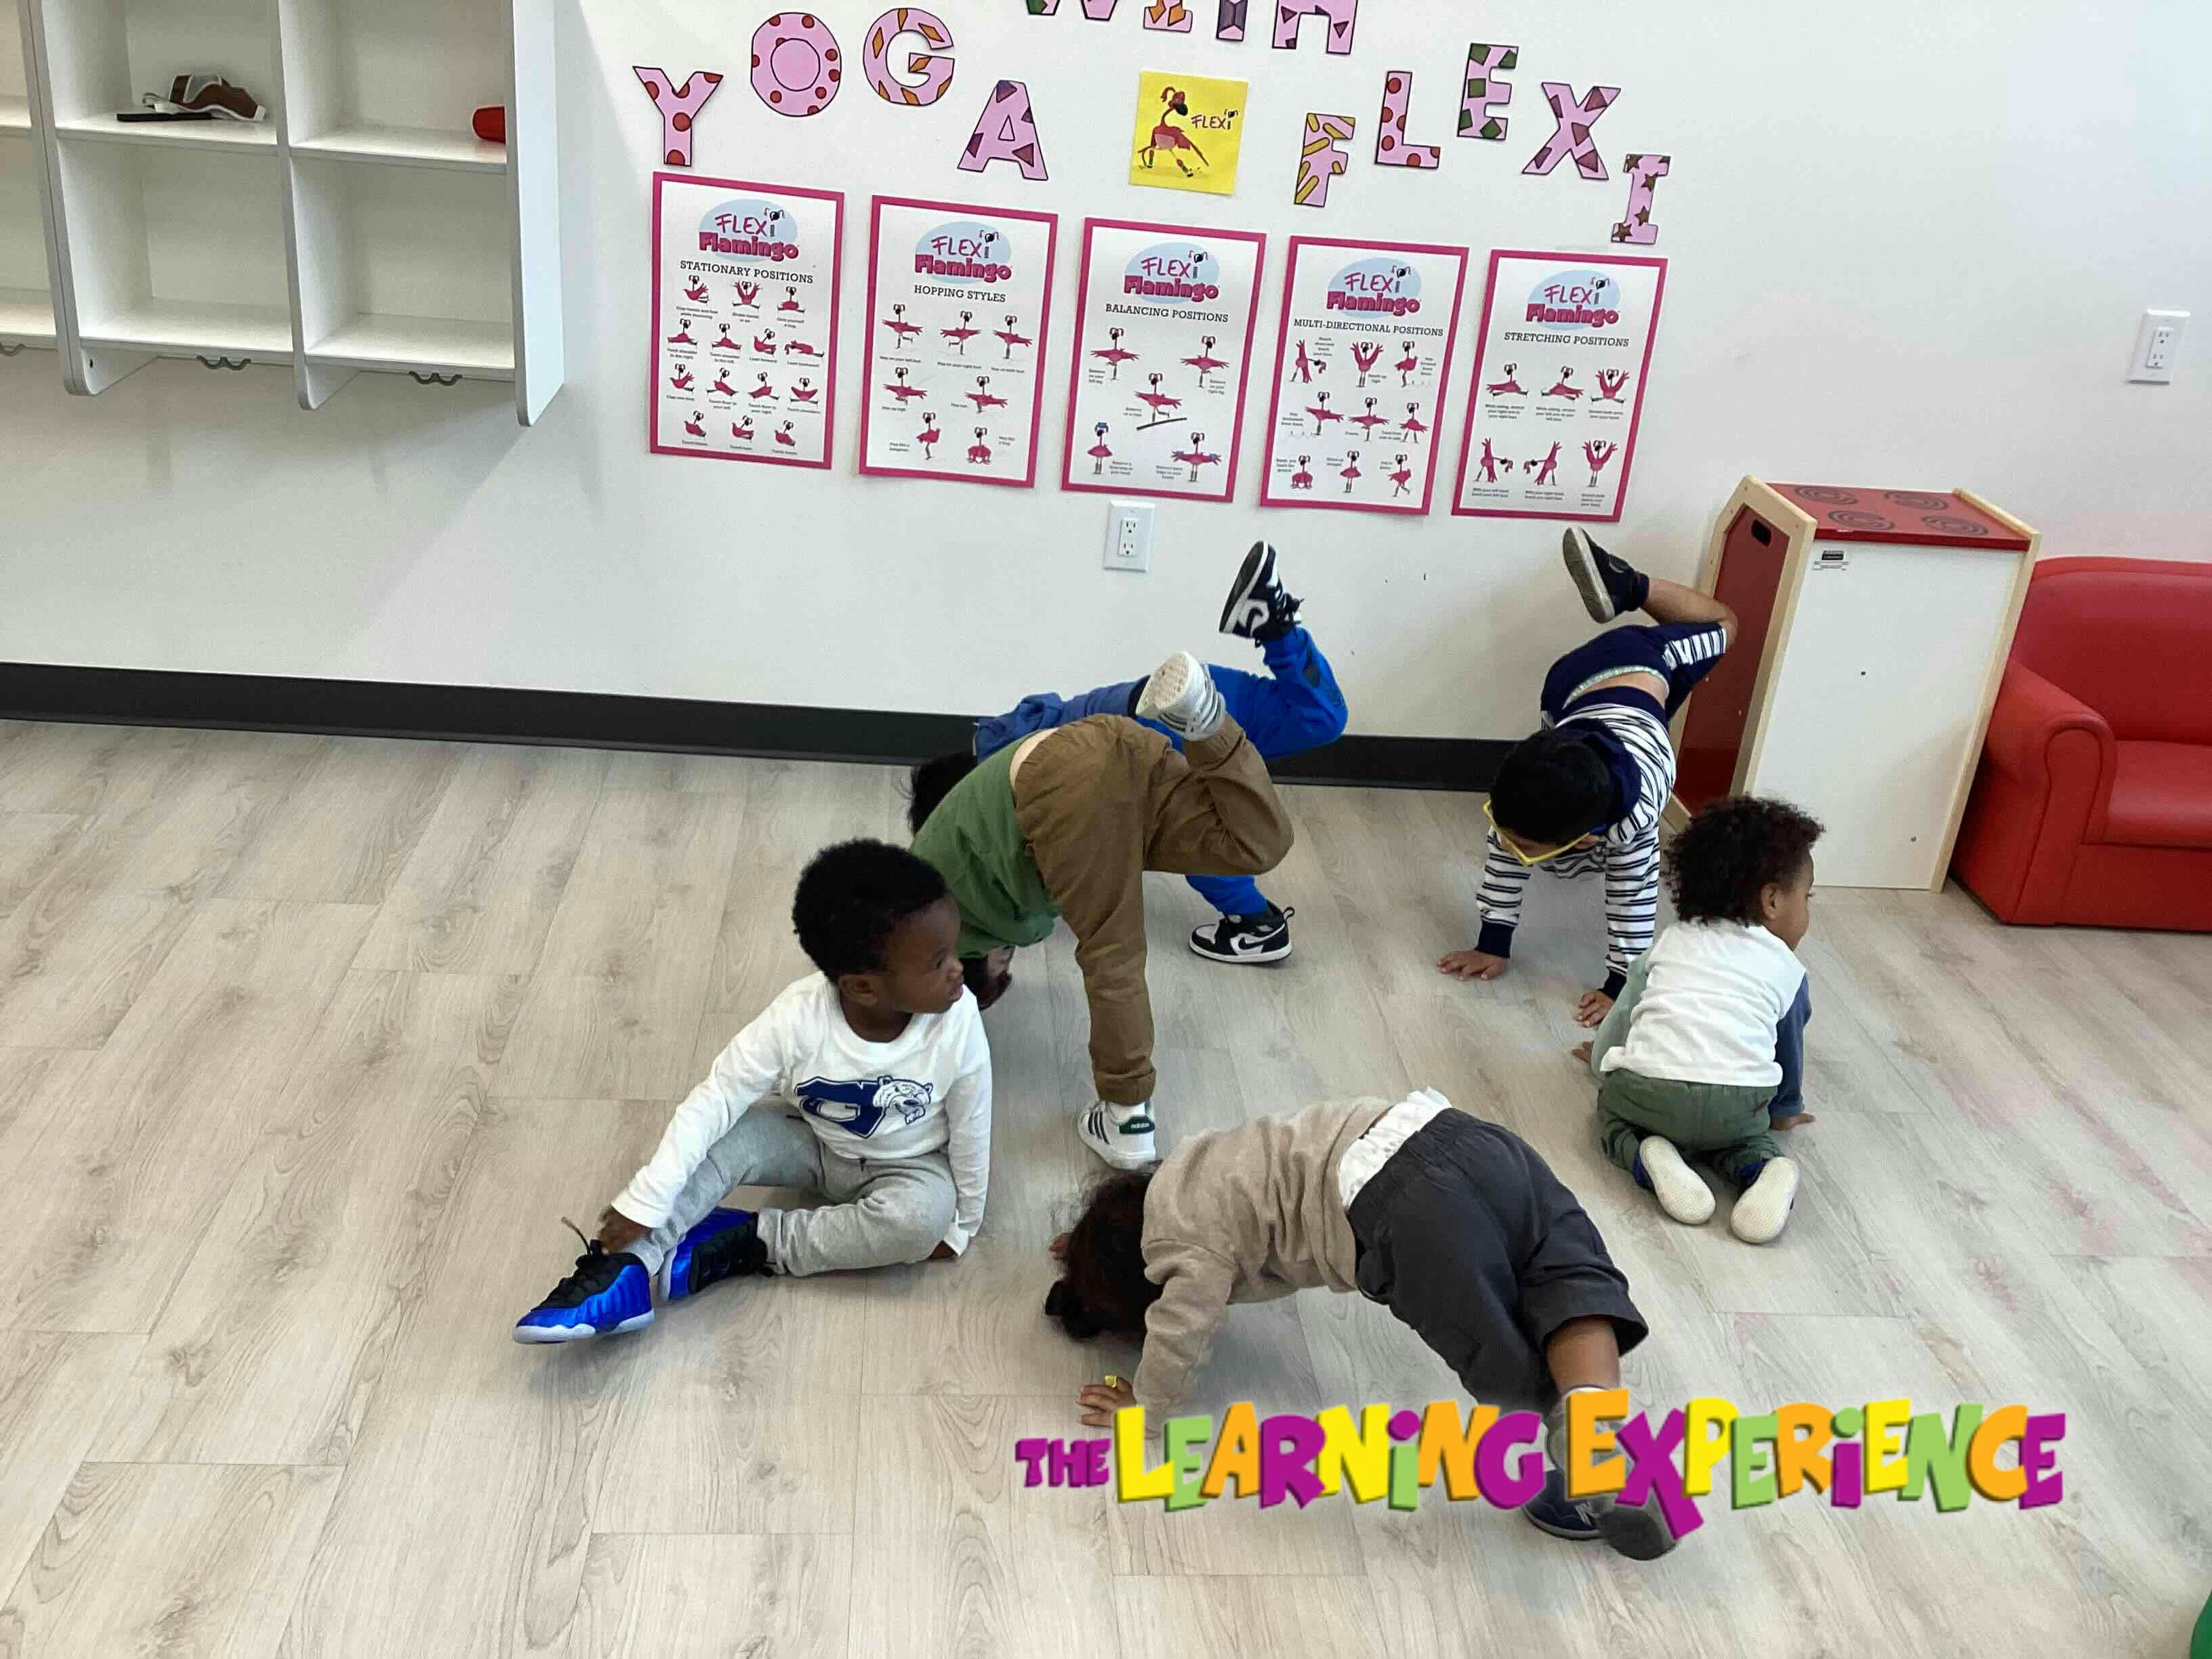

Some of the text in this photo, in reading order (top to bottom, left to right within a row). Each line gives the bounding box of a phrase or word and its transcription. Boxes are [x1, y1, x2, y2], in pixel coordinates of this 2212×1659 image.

[632, 7, 1048, 182] YOGA
[1294, 43, 1671, 245] FLEXI
[699, 231, 799, 262] Flamingo
[680, 260, 813, 284] STATIONARY POSITIONS
[915, 254, 1012, 283] Flamingo
[914, 285, 1006, 302] HOPPING STYLES
[1124, 274, 1219, 302] Flamingo
[1105, 303, 1229, 323] BALANCING POSITIONS
[1326, 291, 1420, 316] Flamingo
[1525, 304, 1619, 327] Flamingo
[1294, 319, 1443, 337] MULTI-DIRECTIONAL POSITIONS
[1504, 331, 1629, 347] STRETCHING POSITIONS
